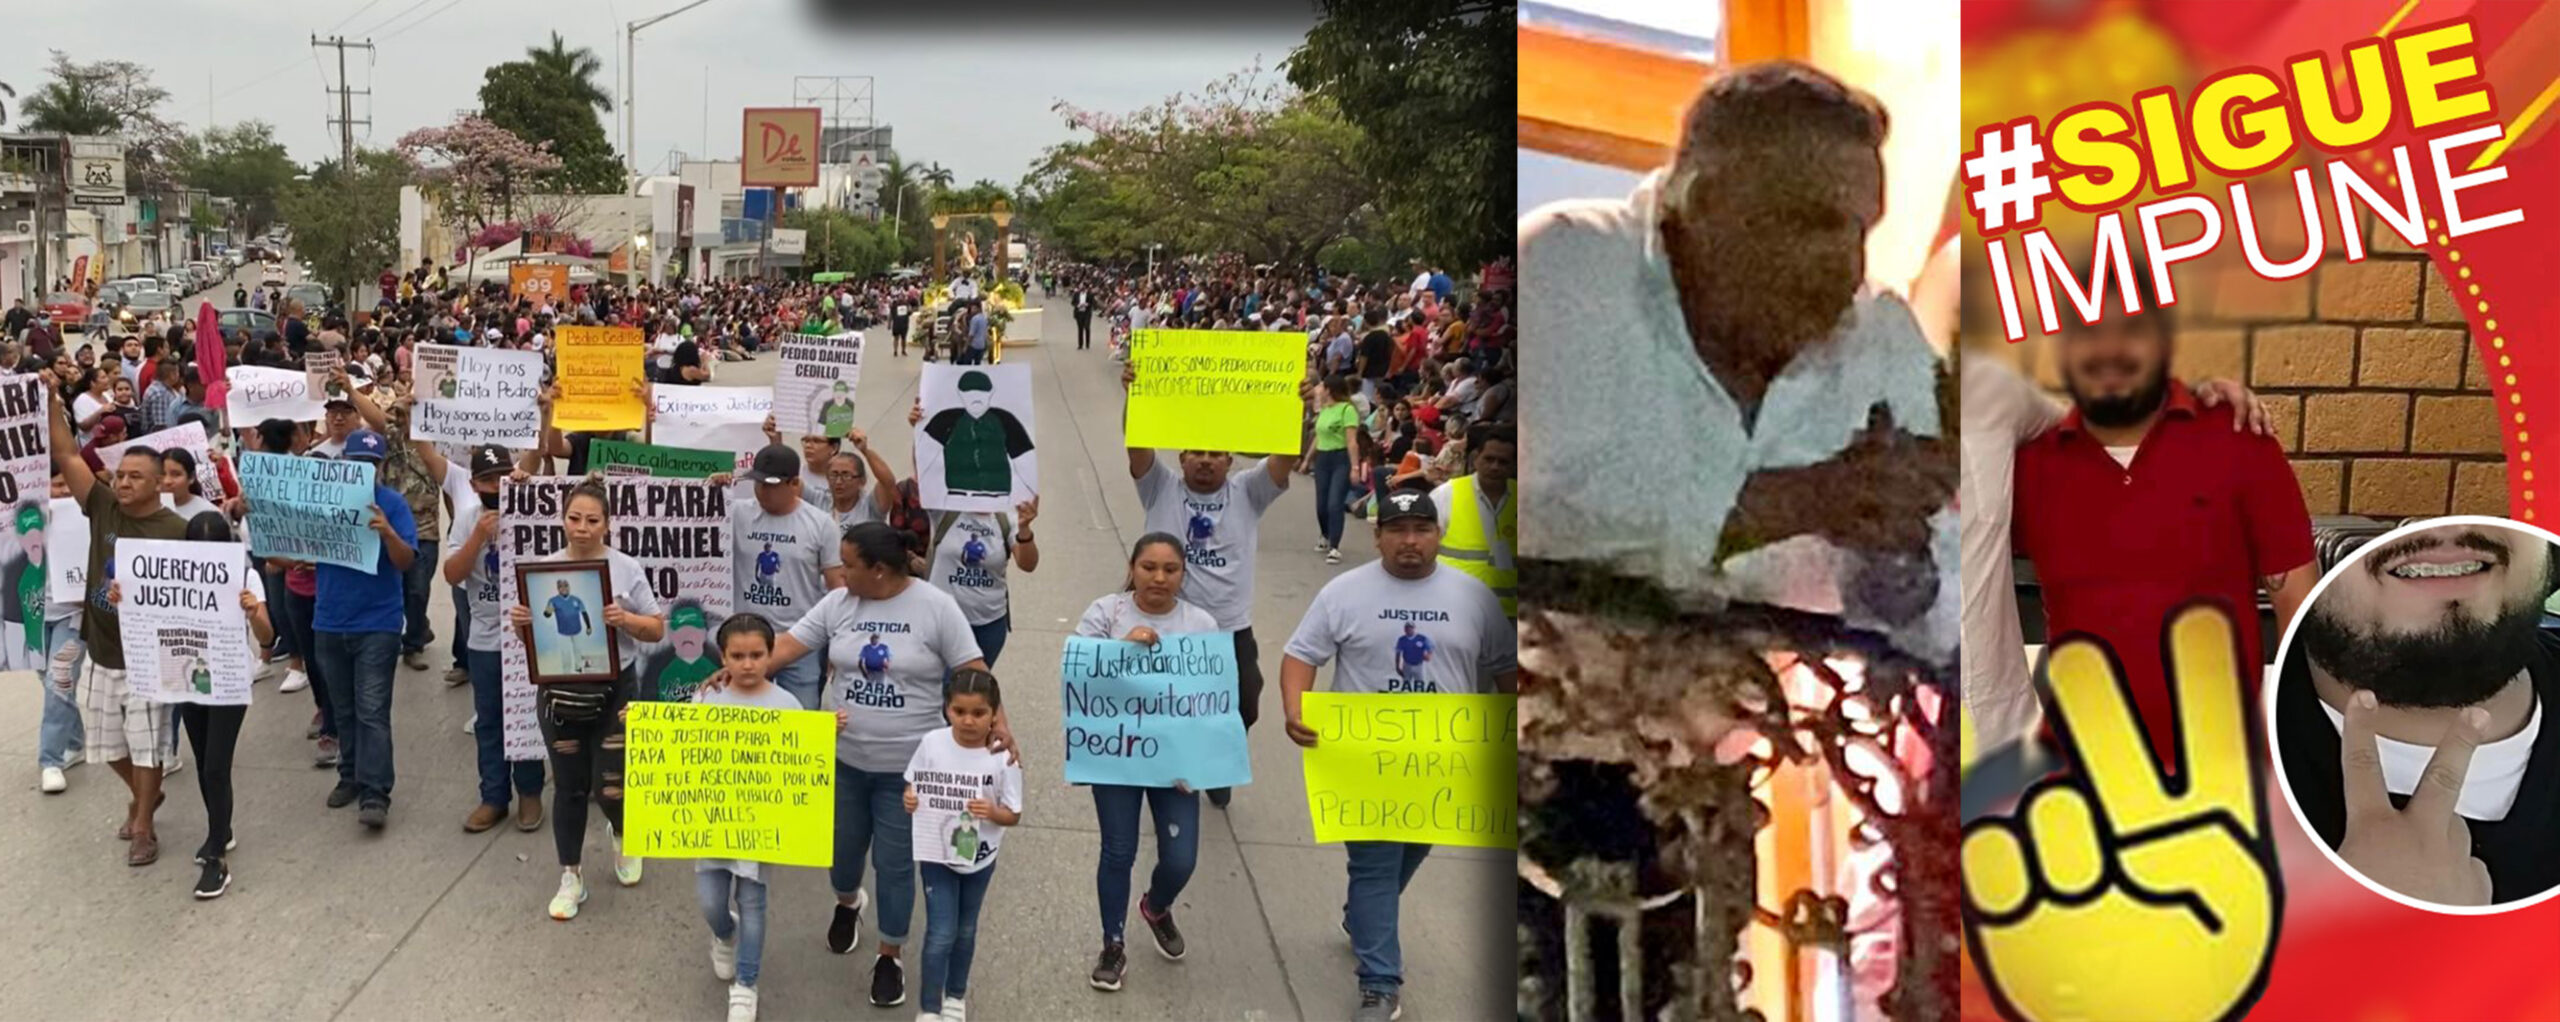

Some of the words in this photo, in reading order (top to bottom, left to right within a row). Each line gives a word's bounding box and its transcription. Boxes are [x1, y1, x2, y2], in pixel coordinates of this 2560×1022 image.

[759, 121, 803, 164] De
[780, 346, 817, 361] PEDRO
[819, 348, 858, 365] DANIEL
[460, 357, 491, 381] Hoy
[498, 363, 525, 377] nos
[795, 363, 840, 380] CEDILLO
[0, 379, 40, 419] RA
[245, 380, 305, 402] PEDRO
[459, 380, 490, 398] Falta
[497, 380, 538, 399] Pedro
[424, 402, 450, 425] Hoy
[453, 411, 491, 422] somos
[494, 408, 506, 422] la
[510, 411, 537, 422] voz
[656, 395, 718, 418] Exigimos
[727, 397, 773, 412] Justicia
[420, 421, 435, 433] de
[440, 422, 456, 436] los
[458, 428, 478, 440] que
[481, 428, 495, 440] ya
[242, 455, 256, 475] SI
[260, 456, 279, 476] NO
[283, 459, 311, 479] HAY
[312, 461, 365, 486] JUSTICIA
[637, 452, 720, 473] callaremos
[278, 480, 291, 501] EL
[297, 482, 344, 506] PUEBLO
[505, 483, 639, 517] JUSTIA
[646, 484, 726, 518] PARA
[272, 502, 292, 518] NO
[296, 504, 328, 523] HAYA
[330, 507, 363, 527] PAZ
[620, 525, 724, 559] DANIEL
[747, 531, 797, 545] JUSTICIA
[132, 555, 230, 585] QUEREMOS
[957, 567, 988, 578] PARA
[750, 583, 783, 597] PARA
[949, 575, 994, 588] PEDRO
[134, 585, 219, 612] JUSTICIA
[744, 591, 791, 607] PEDRO
[1378, 608, 1450, 622] JUSTICIA
[157, 628, 189, 638] JUSTICIA
[190, 629, 209, 639] PARA
[851, 621, 912, 635] JUSTICIA
[159, 638, 185, 647] PEDRO
[185, 638, 209, 650] DANIEL
[171, 647, 199, 658] CEDILLO
[1063, 636, 1224, 679] #JusticiaParaPedro
[854, 679, 896, 697] PARA
[1388, 679, 1438, 693] PARA
[845, 688, 905, 709] PEDRO
[1066, 681, 1118, 718] Nos
[706, 706, 782, 725] OBRADOR
[1321, 704, 1517, 743] JUSTICIA
[671, 728, 730, 744] JUSTICIA
[735, 730, 771, 746] PARA
[782, 732, 799, 748] MI
[629, 748, 666, 766] PAPA
[681, 748, 723, 765] PEDRO
[731, 749, 767, 765] DANIEL
[770, 750, 811, 766] CEDILLO
[1373, 750, 1473, 779] PARA
[627, 771, 655, 788] QUE
[666, 771, 691, 786] FUE
[700, 769, 772, 786] ASECINADO
[783, 772, 806, 787] POR
[811, 773, 830, 787] UN
[914, 770, 953, 784] JUSTICIA
[955, 774, 979, 787] PARA
[644, 789, 726, 806] FUNCIONARIO
[736, 789, 783, 805] PUBLICO
[793, 792, 809, 806] DE
[916, 784, 945, 797] PEDRO
[946, 787, 977, 800] DANIEL
[929, 798, 964, 811] CEDILLO
[703, 807, 756, 824] VALLES
[646, 829, 662, 852] ¡Y
[671, 829, 713, 849] SIGUE
[725, 828, 781, 851] LIBRE!
